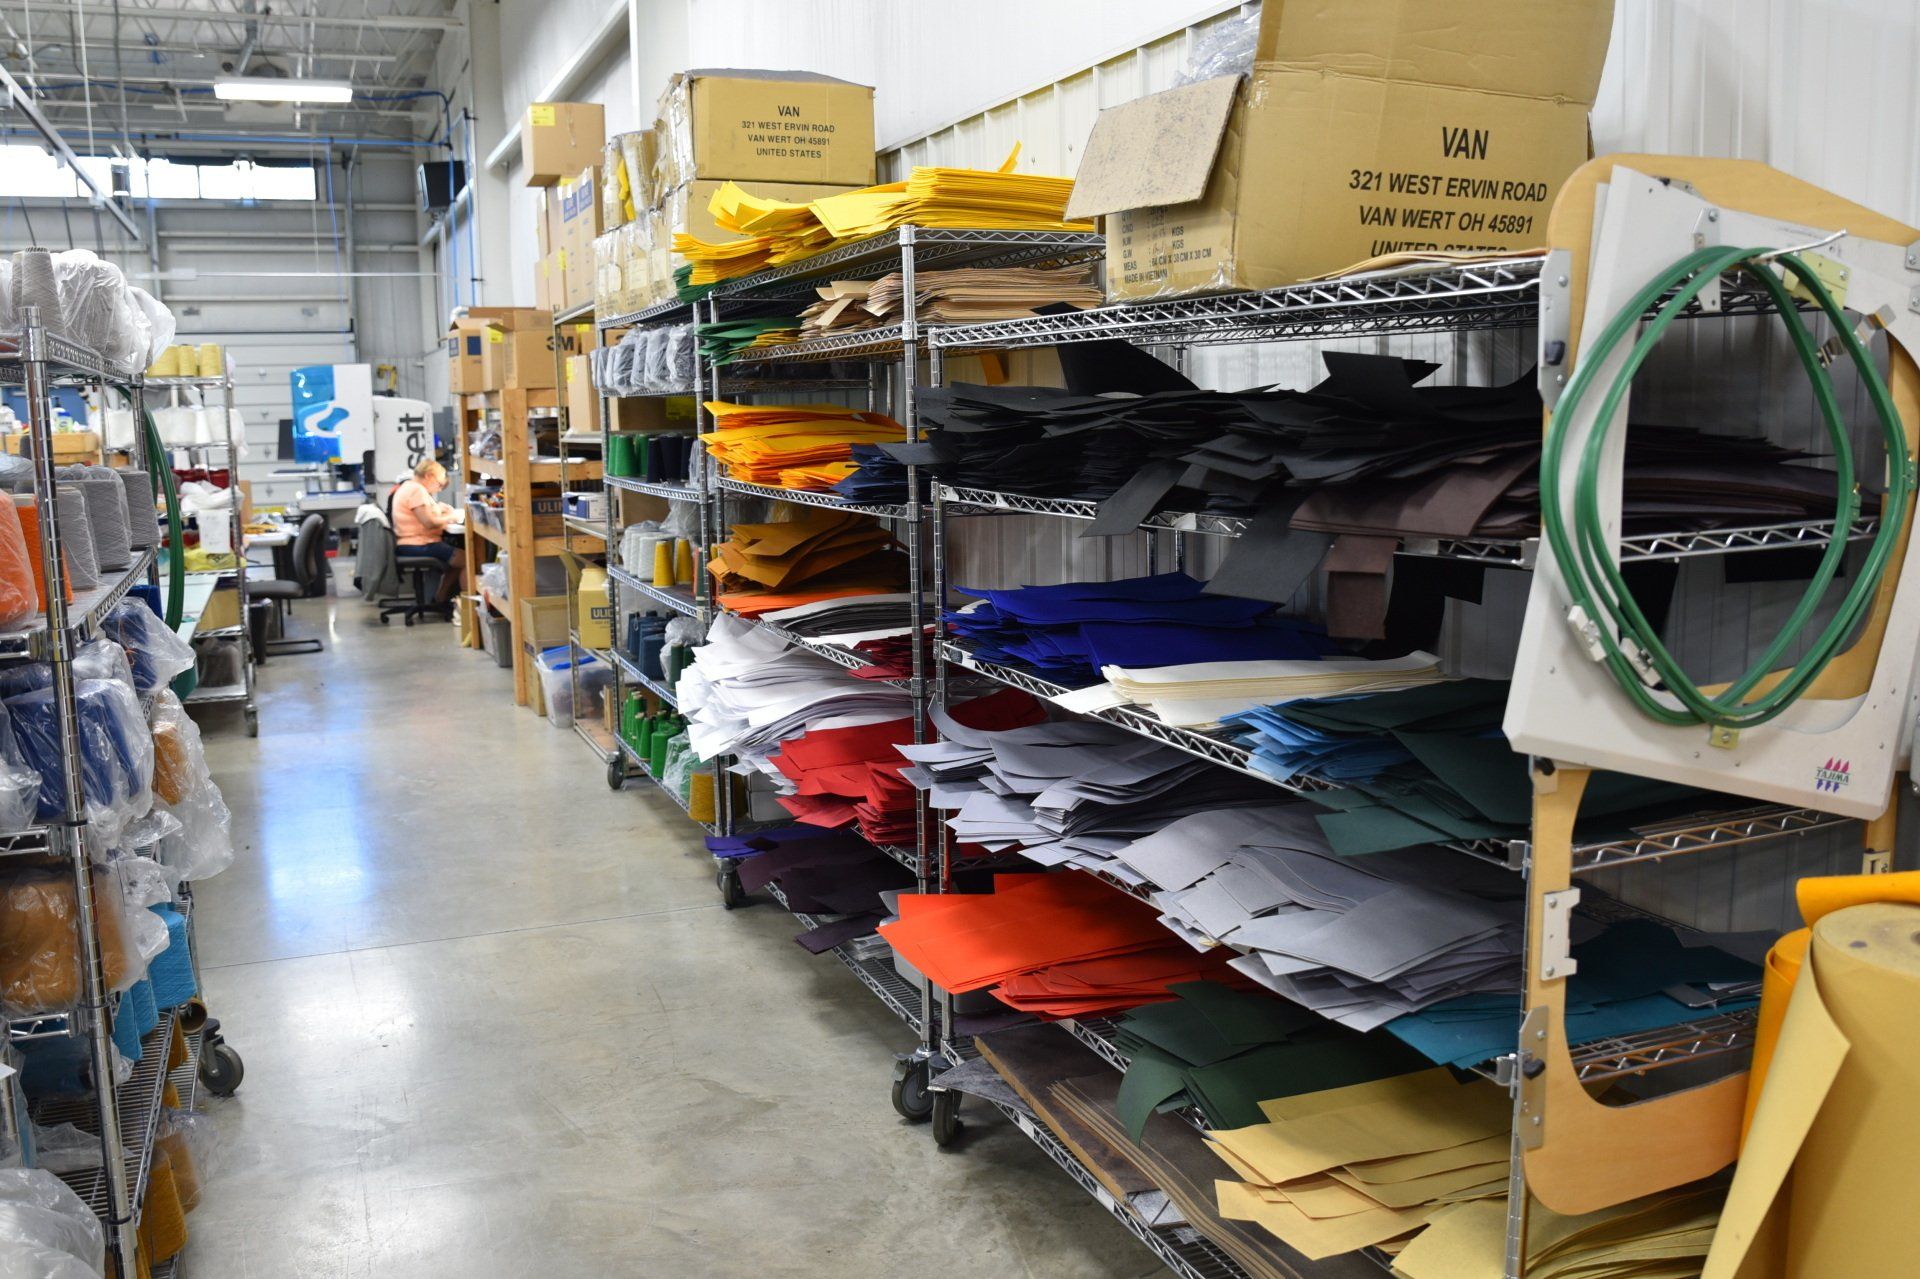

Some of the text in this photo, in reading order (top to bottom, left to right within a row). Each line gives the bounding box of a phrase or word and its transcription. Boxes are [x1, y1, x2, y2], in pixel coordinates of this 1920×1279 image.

[778, 105, 800, 118] VAN
[741, 121, 835, 133] 321 WEST ERVIN ROAD
[748, 134, 831, 146] VAN WERT OH 45891
[1442, 126, 1489, 160] VAN
[756, 148, 822, 159] UNITED STATES
[1349, 169, 1547, 202] 321 WEST ERVIN ROAD
[1359, 205, 1533, 234] VAN WERT OH 45891
[546, 335, 574, 351] 3M
